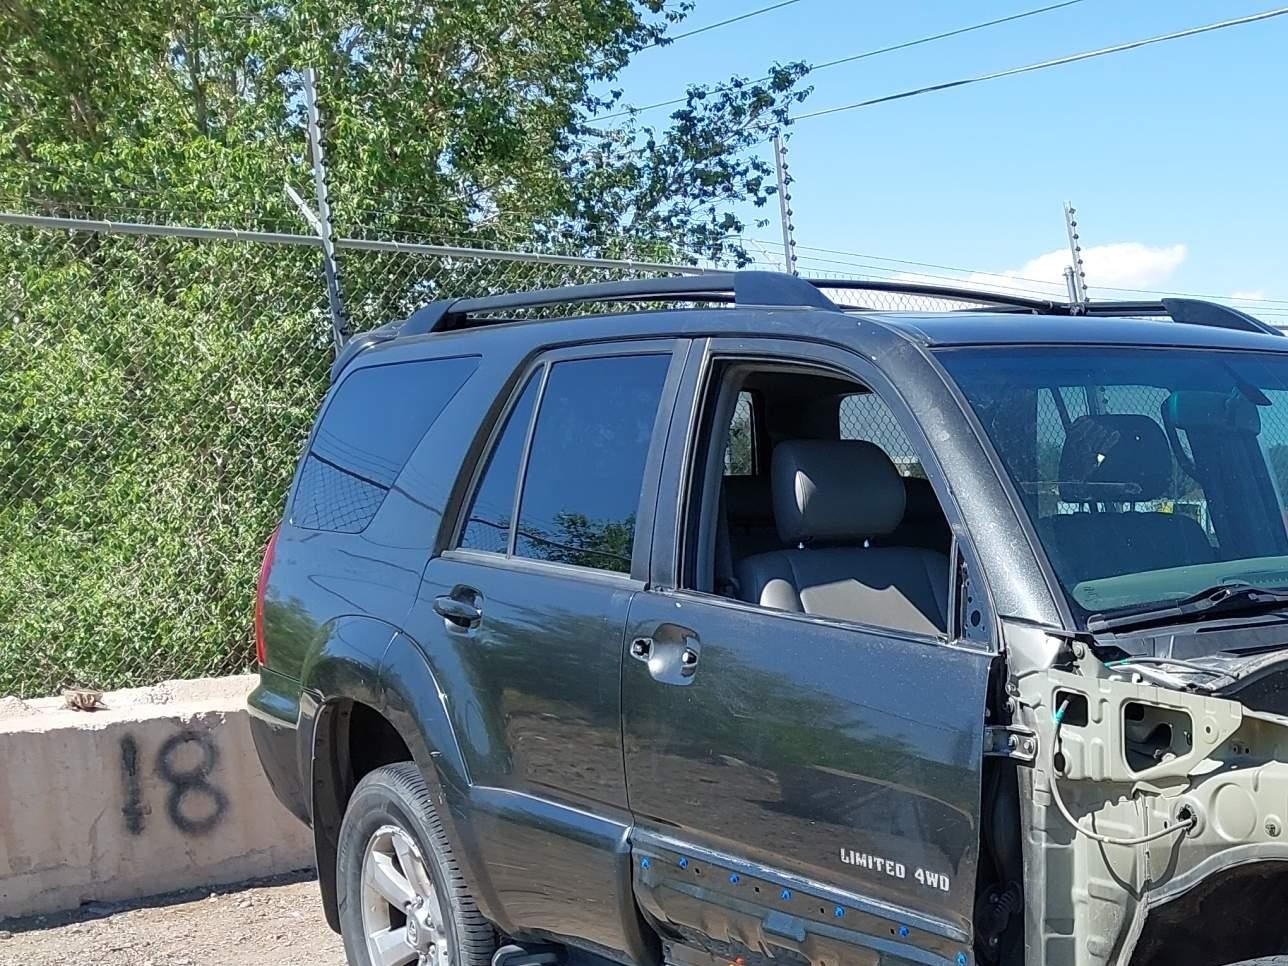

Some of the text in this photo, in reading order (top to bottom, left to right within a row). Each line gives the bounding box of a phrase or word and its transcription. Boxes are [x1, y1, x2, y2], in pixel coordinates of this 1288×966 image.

[121, 731, 229, 836] 18
[840, 848, 950, 892] LIMITED 4WD
